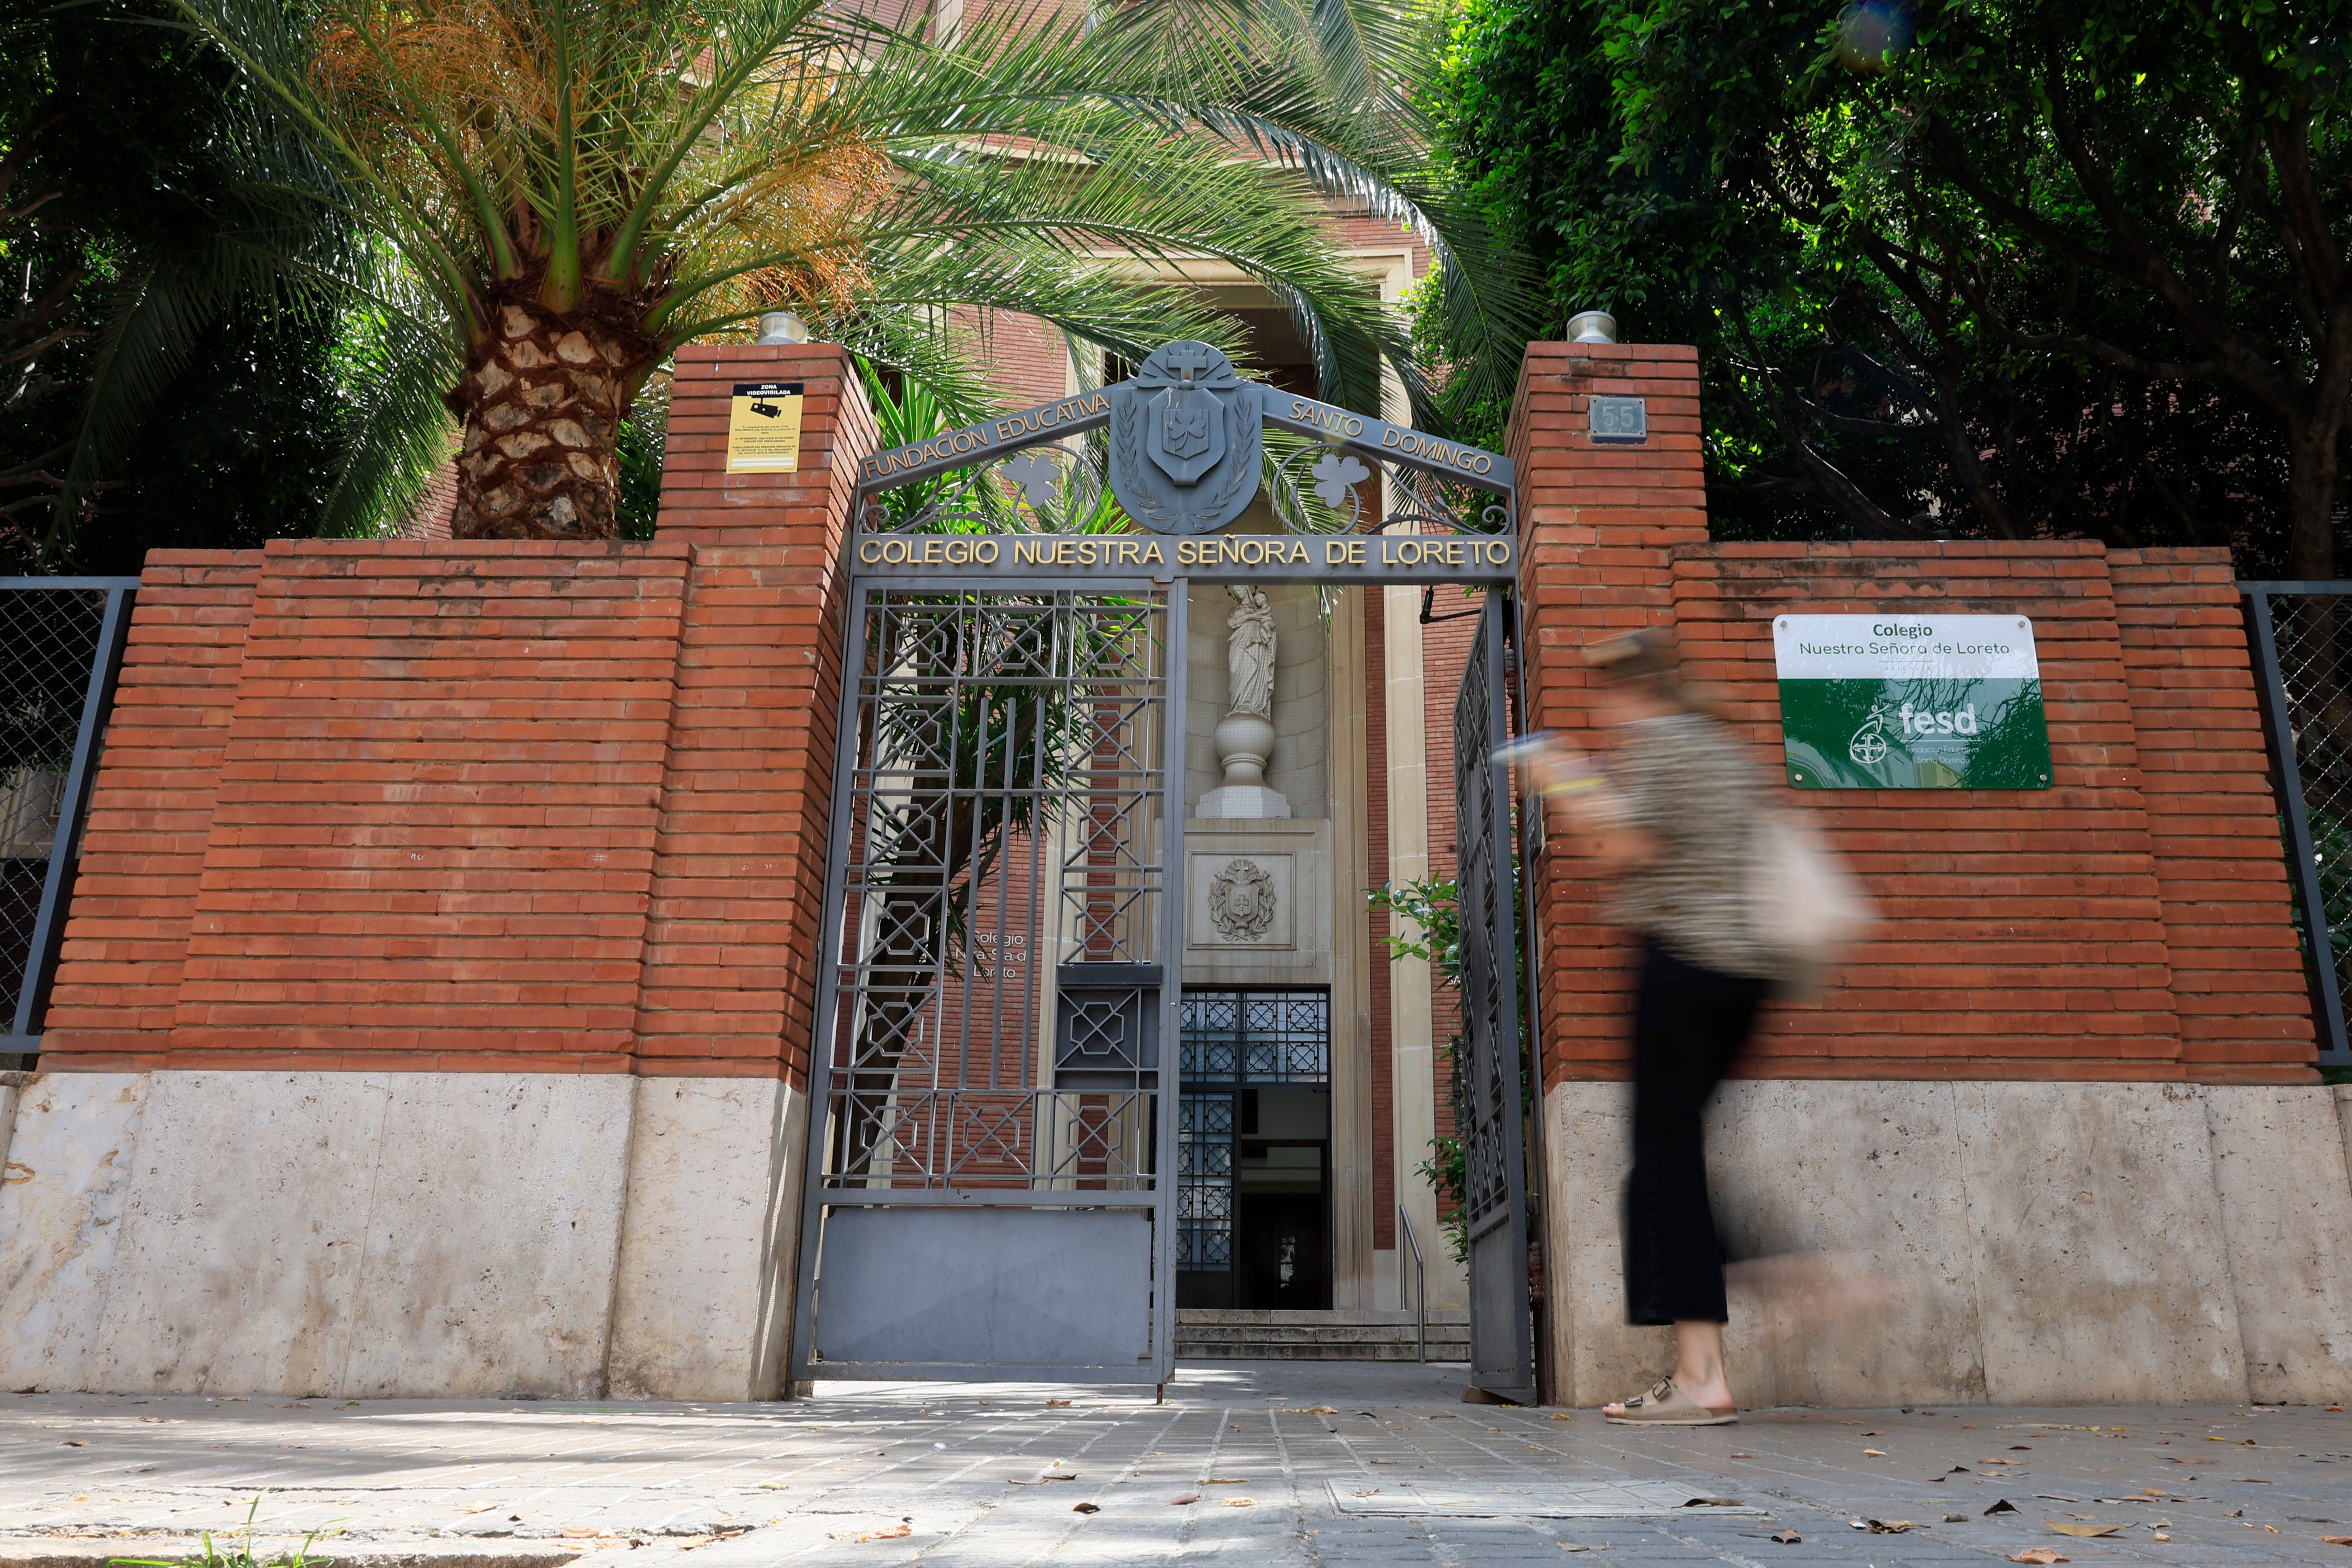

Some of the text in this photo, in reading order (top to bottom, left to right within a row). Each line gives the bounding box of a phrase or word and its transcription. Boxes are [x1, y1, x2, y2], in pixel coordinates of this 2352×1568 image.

[1603, 406, 1634, 428] 55
[863, 394, 1110, 479] FUNDACIÓN EDUCATIVA
[1288, 401, 1492, 474] SANTO DOMINGO
[860, 534, 1510, 564] COLEGIO NUESTRA SEÑORA DE LORETO
[1873, 624, 1933, 639] Colegio
[1800, 642, 2009, 654] Nuestra Señora de Loreto
[1899, 703, 1977, 734] fesd
[1906, 745, 1942, 753] Fundación
[956, 947, 987, 960] Nra.
[974, 965, 1016, 978] Lorto
